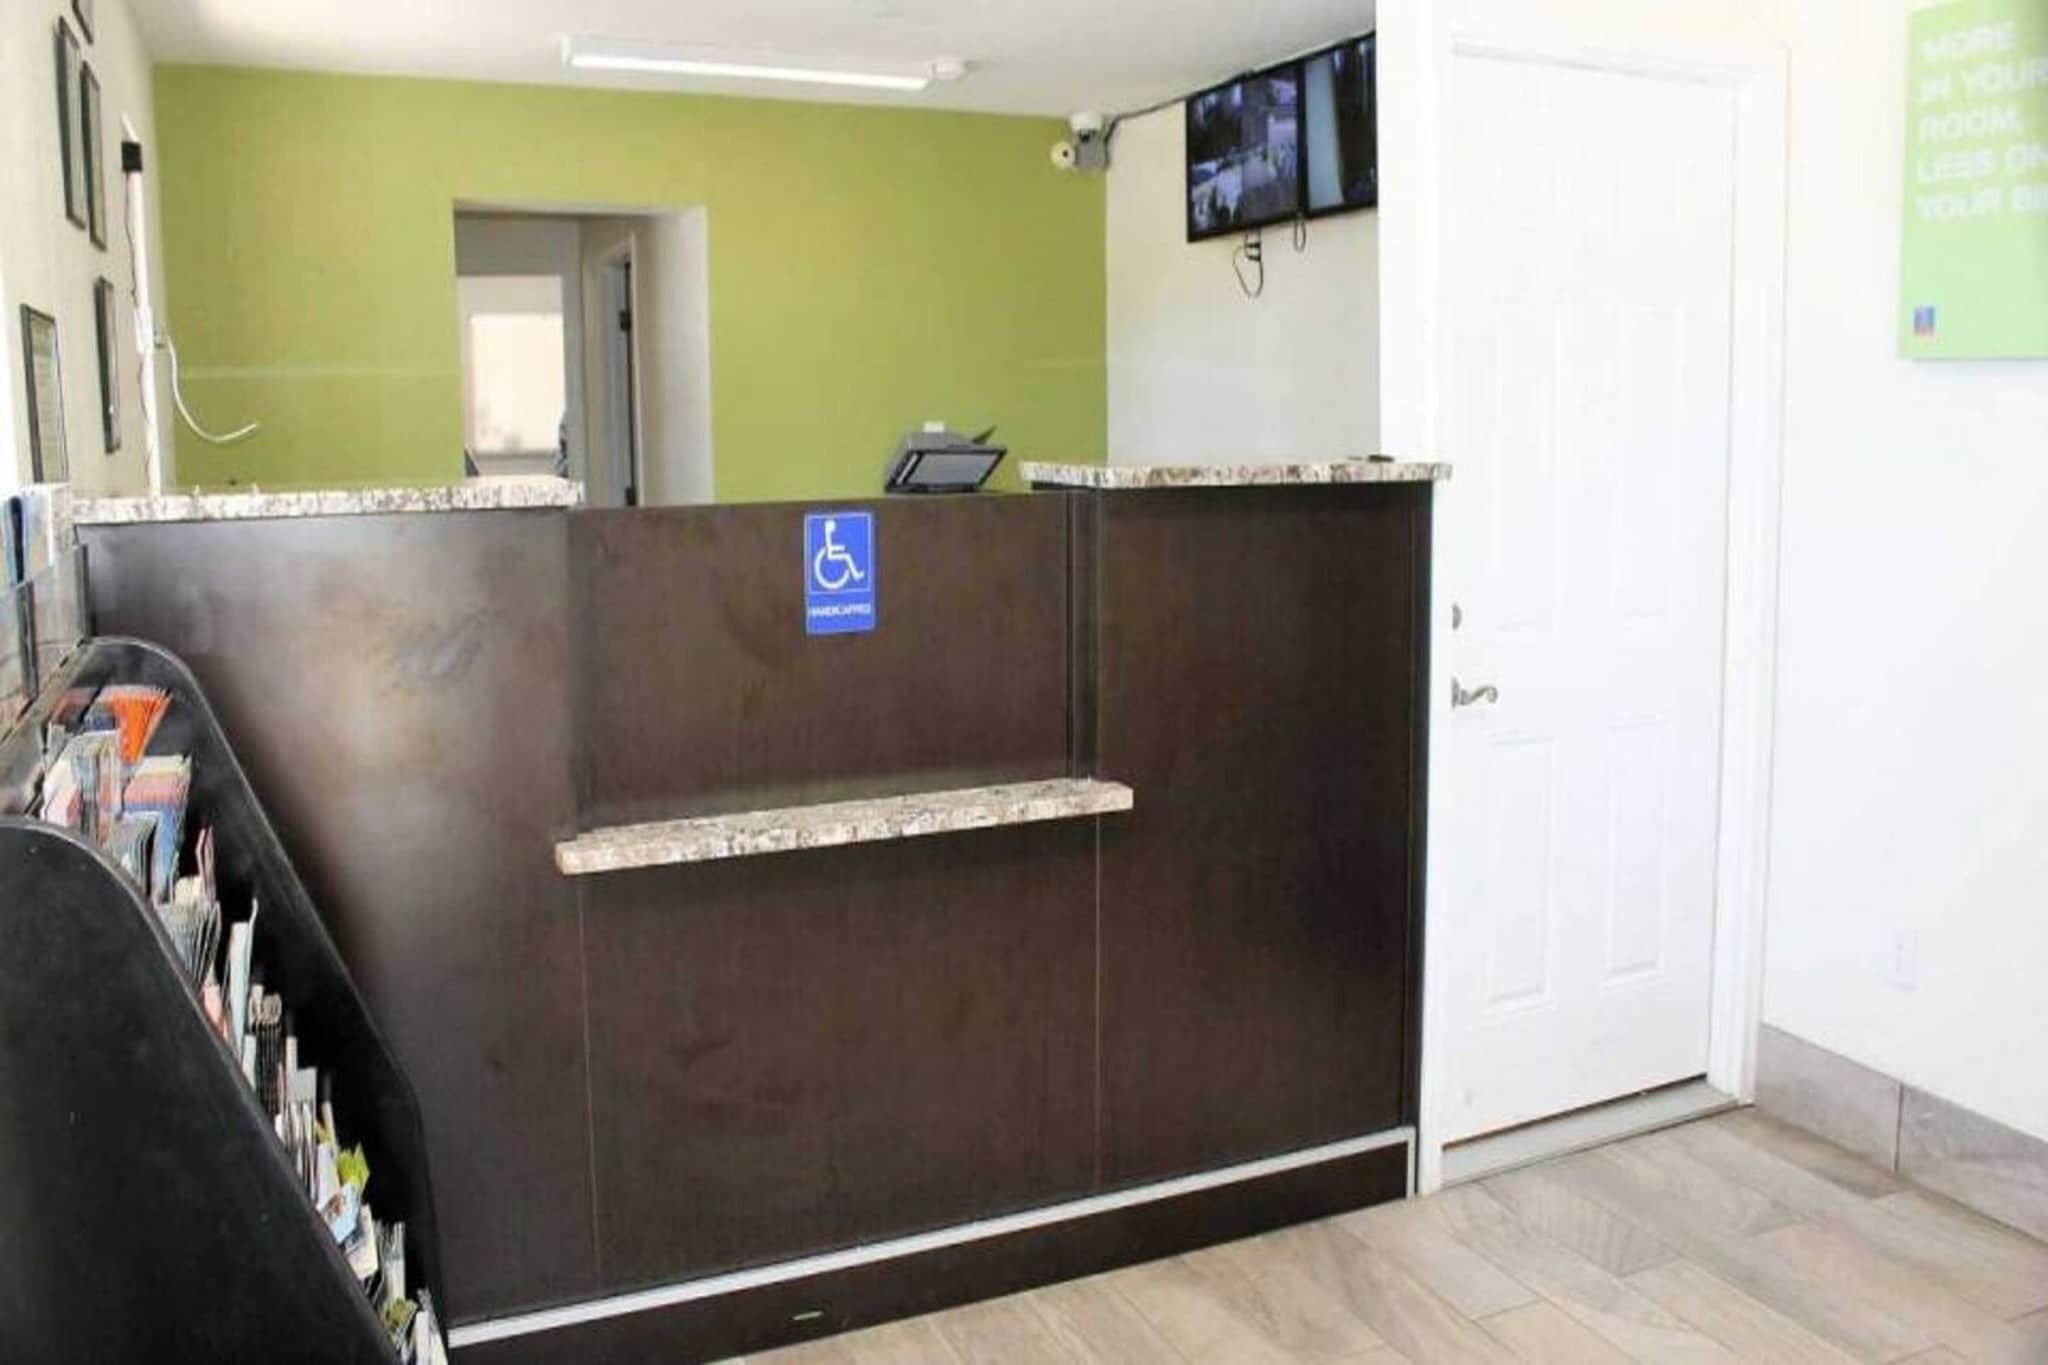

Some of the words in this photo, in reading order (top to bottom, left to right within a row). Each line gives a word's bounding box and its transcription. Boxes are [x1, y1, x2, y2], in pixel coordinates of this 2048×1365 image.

[1920, 21, 2016, 61] MORE
[1919, 72, 1952, 102] IN
[1917, 149, 1995, 183] LESS
[1919, 187, 2002, 222] YOUR
[808, 603, 872, 617] HANDICAPPED
